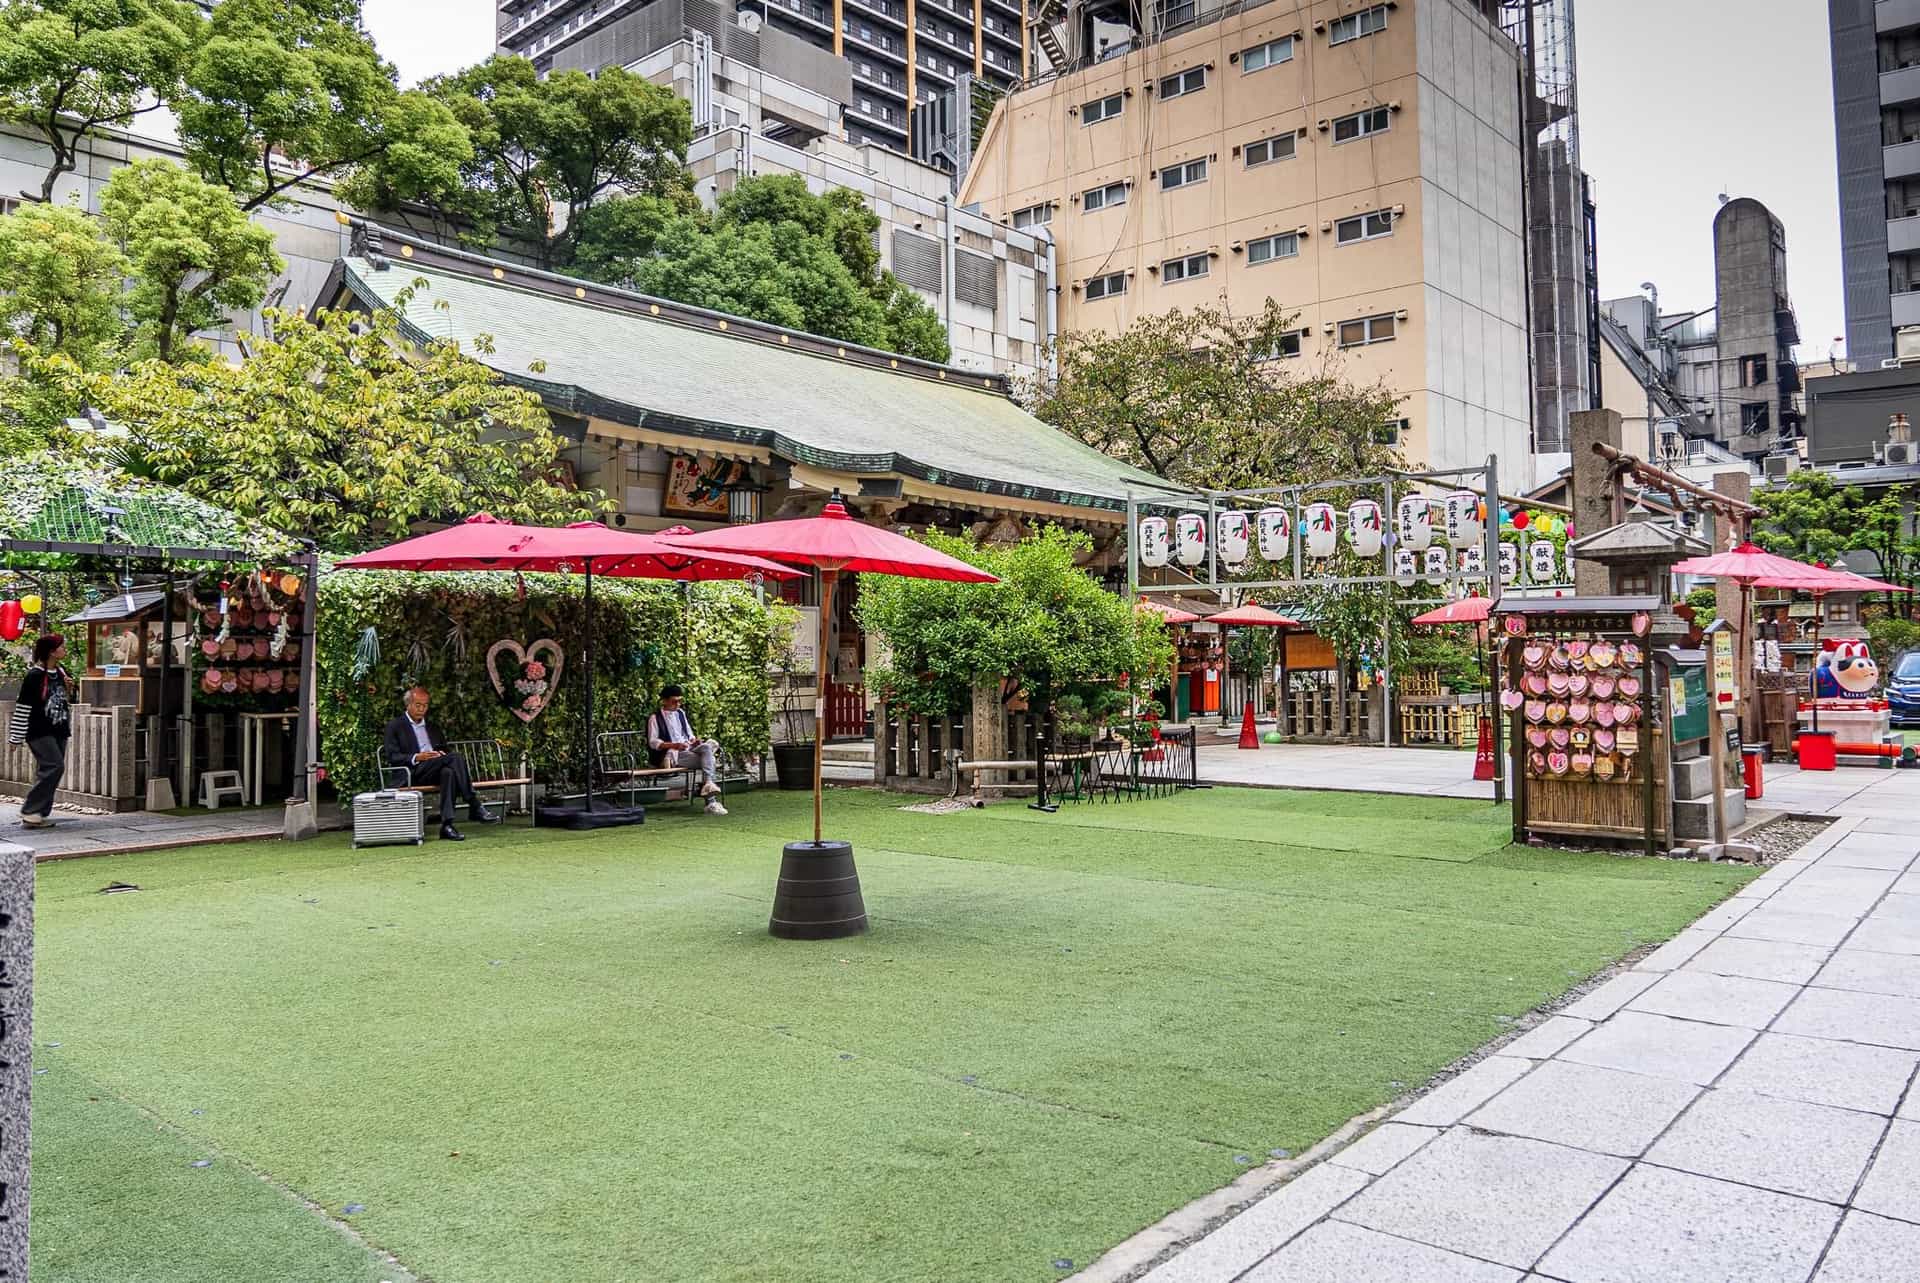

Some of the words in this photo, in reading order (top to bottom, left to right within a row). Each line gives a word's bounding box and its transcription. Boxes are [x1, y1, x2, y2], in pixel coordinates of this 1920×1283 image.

[1401, 504, 1414, 541] 露天神社
[1447, 500, 1459, 538] 露天神社
[1144, 524, 1155, 557] 露天神社
[1536, 547, 1549, 572] 献燈
